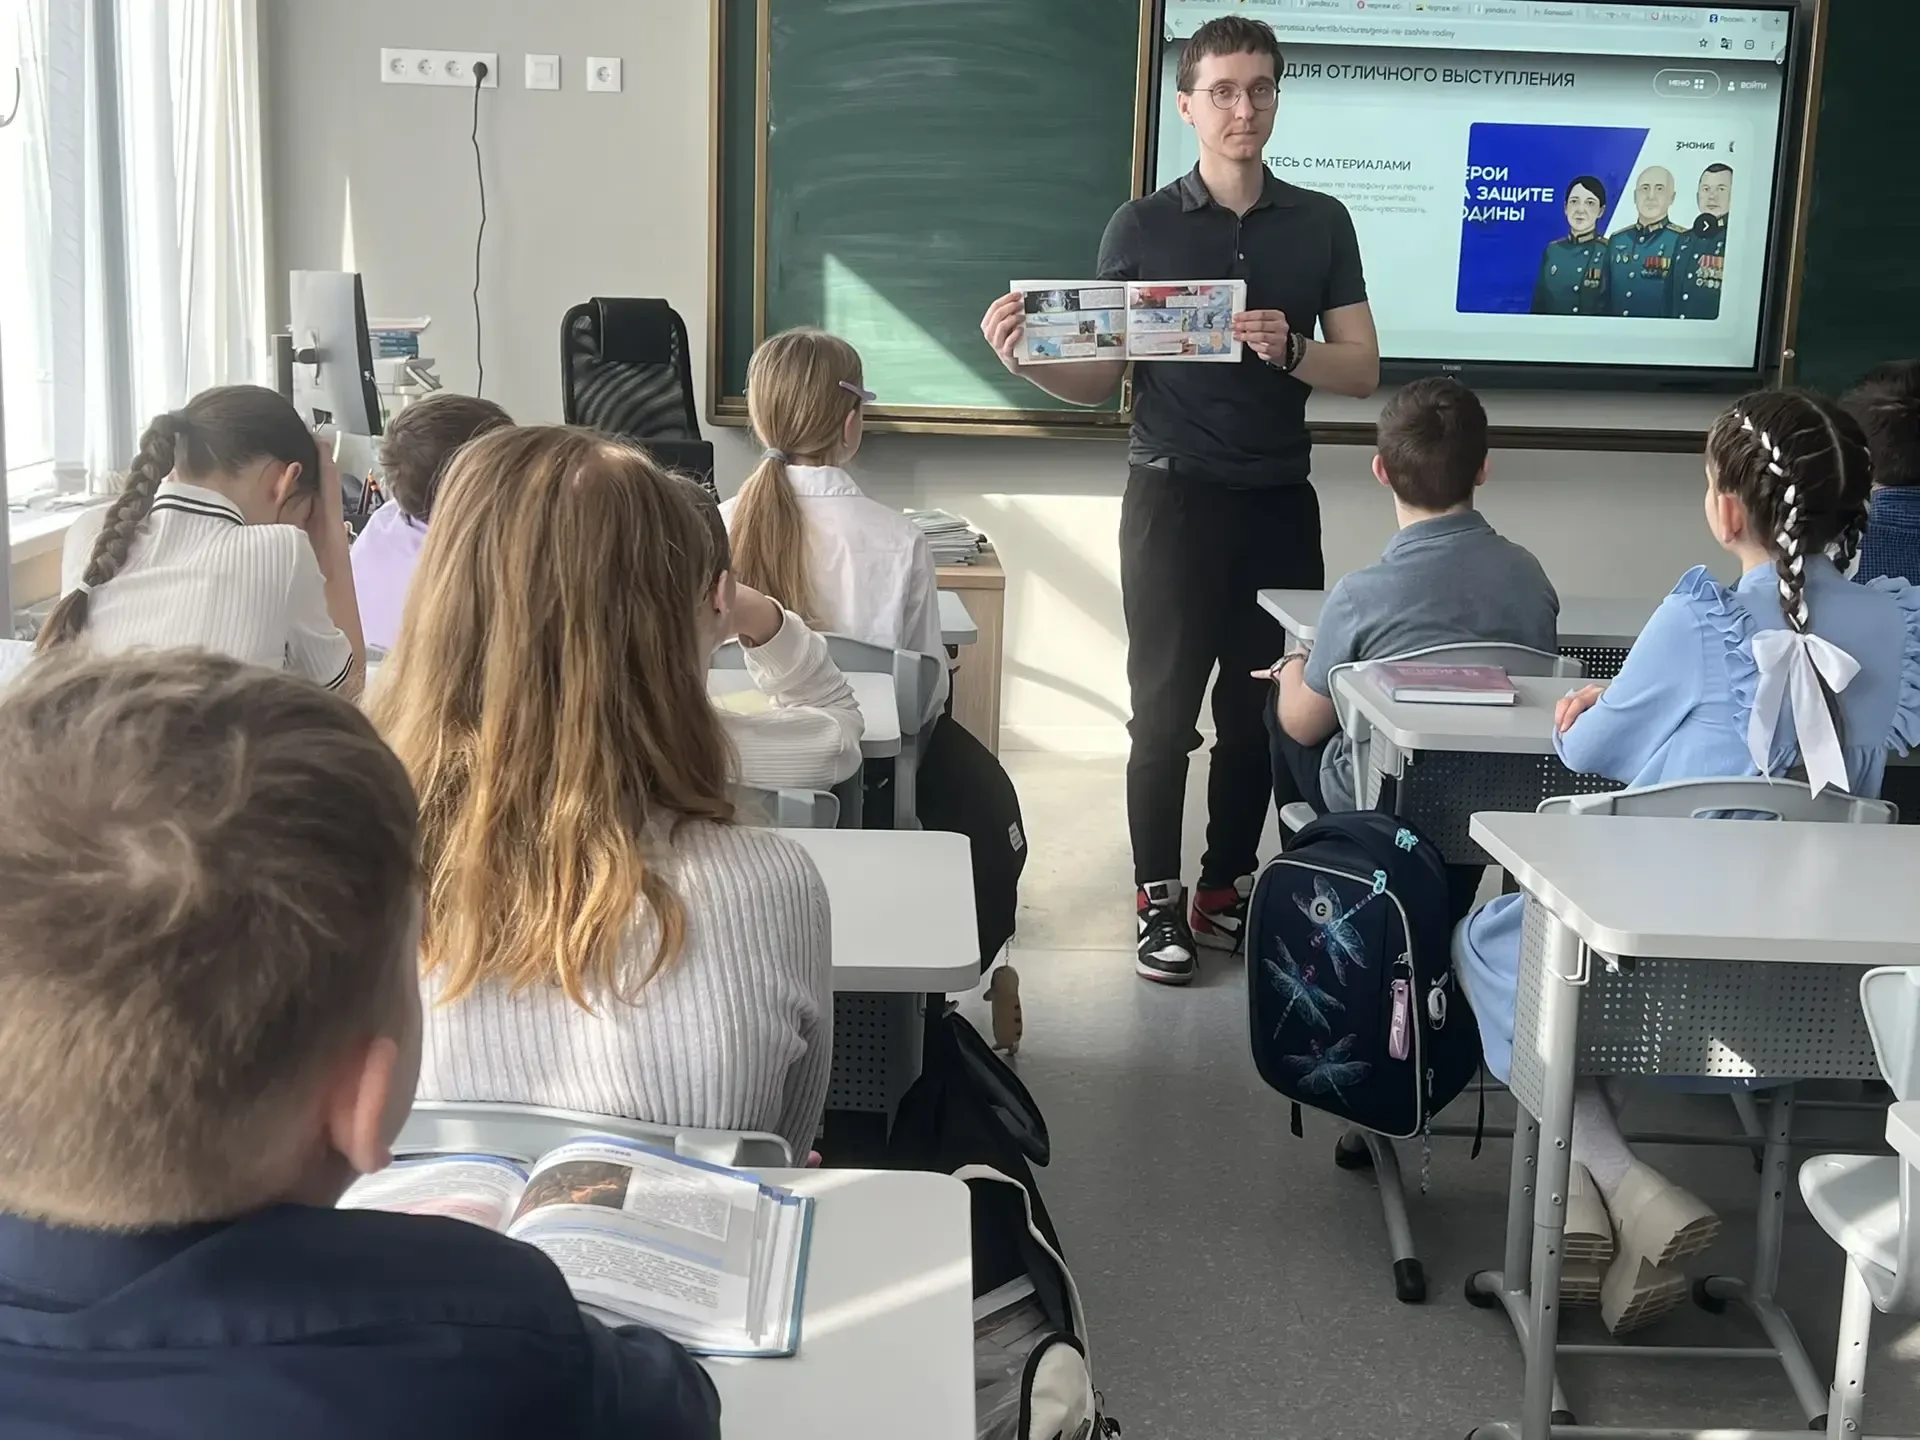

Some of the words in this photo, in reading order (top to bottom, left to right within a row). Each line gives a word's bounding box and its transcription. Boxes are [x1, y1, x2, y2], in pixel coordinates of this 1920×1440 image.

[1284, 63, 1322, 79] ДЛЯ
[1326, 64, 1438, 82] ОТЛИЧНОГО
[1442, 68, 1576, 87] ВЫСТУПЛЕНИЯ
[1740, 80, 1768, 90] ВОЙТИ
[1303, 157, 1313, 168] С
[1315, 159, 1412, 171] МАТЕРИАЛАМИ
[1476, 186, 1555, 204] ЗАЩИТЕ
